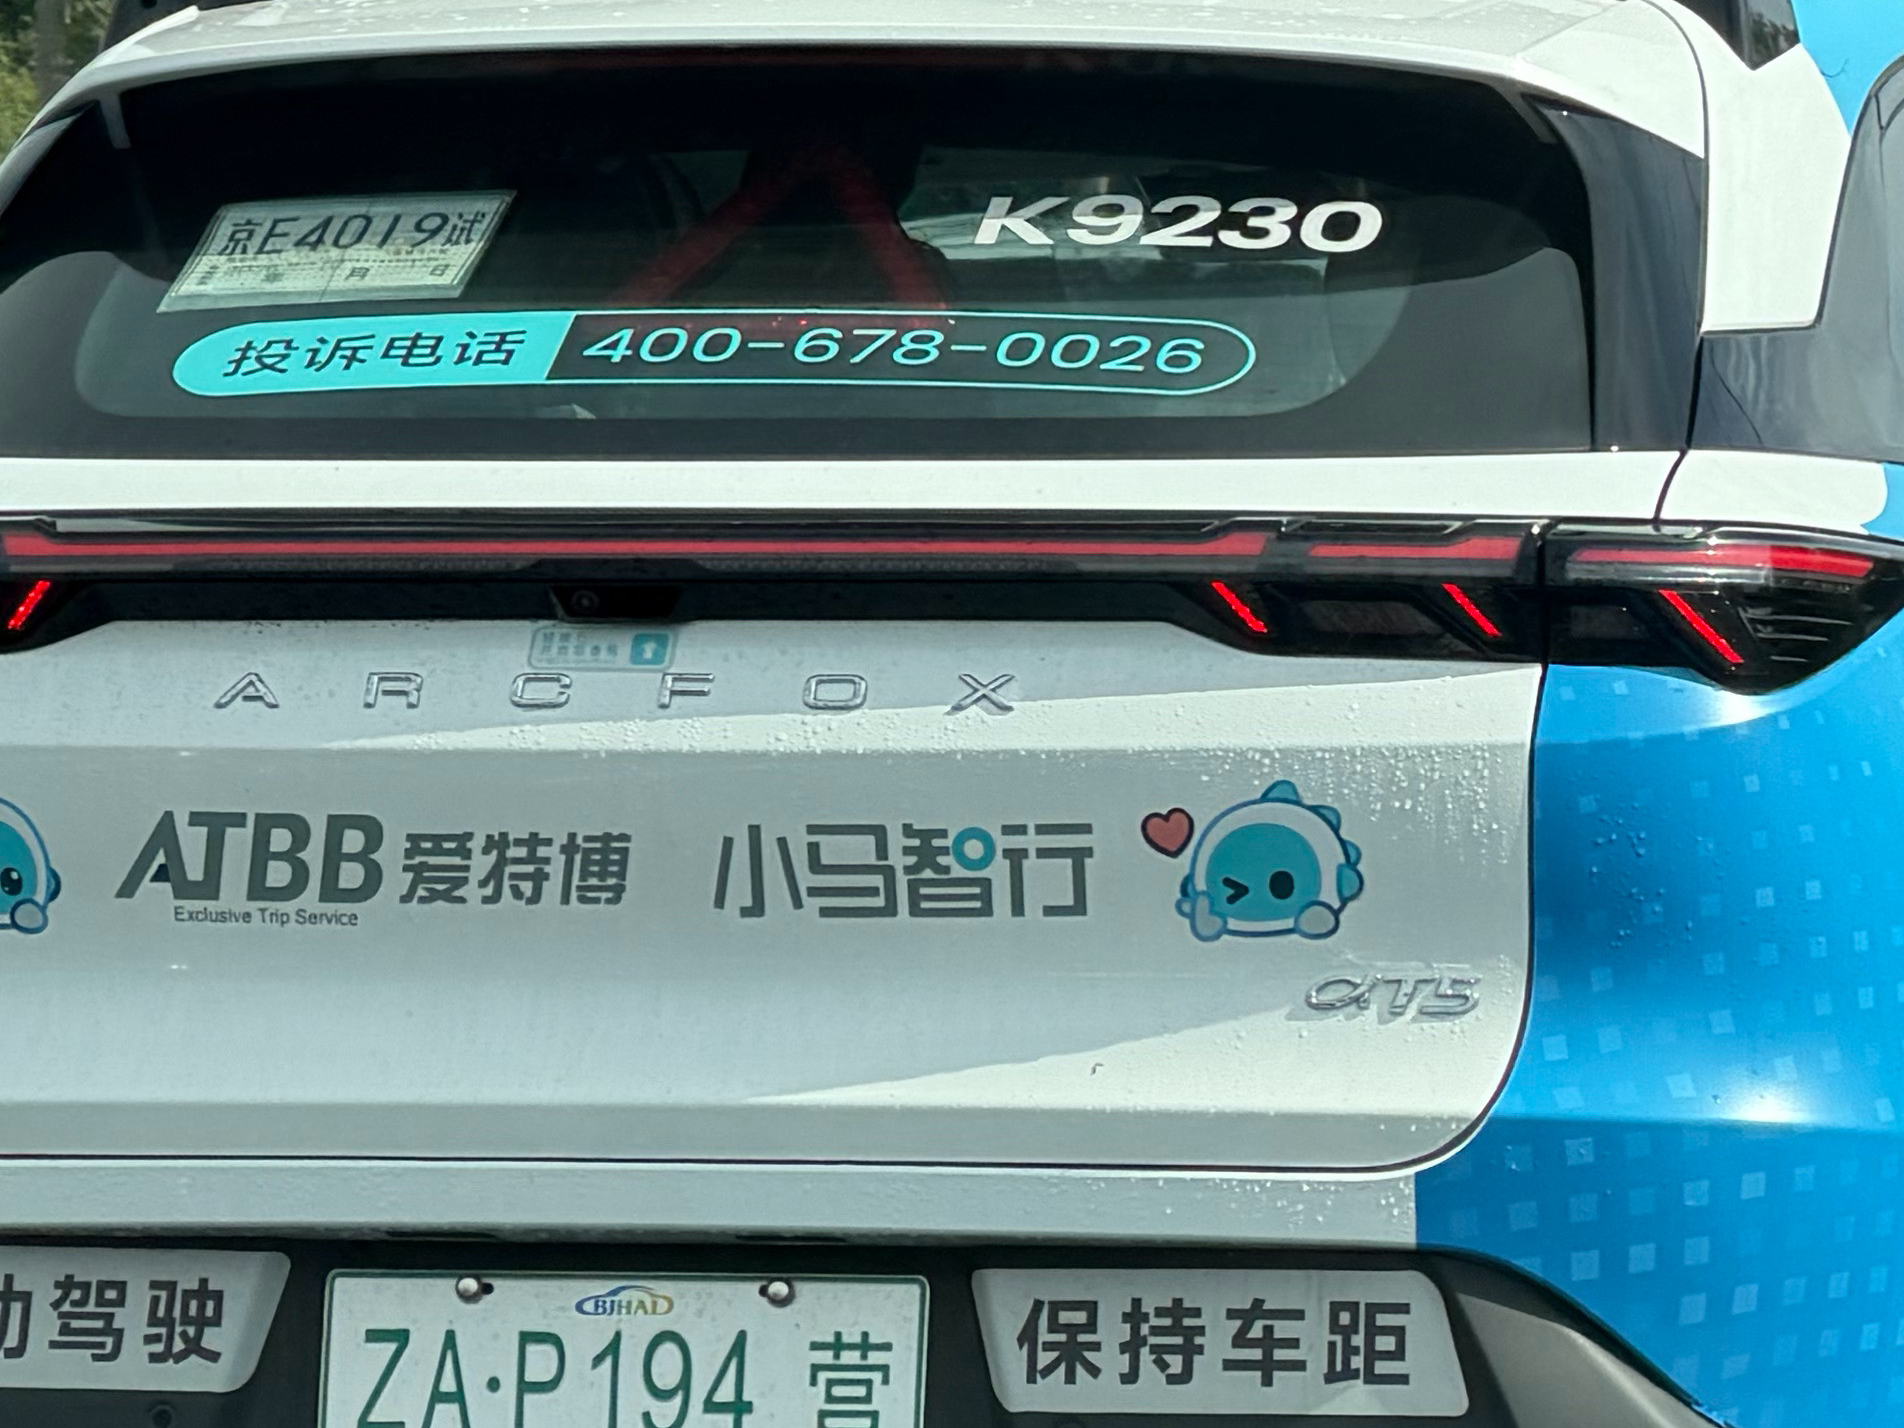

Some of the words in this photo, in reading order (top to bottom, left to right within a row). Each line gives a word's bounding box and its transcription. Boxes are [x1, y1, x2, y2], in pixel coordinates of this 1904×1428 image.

[217, 211, 487, 256] 京E4019试
[972, 194, 1383, 253] K9230
[222, 329, 528, 378] 投诉电话
[581, 325, 1205, 374] 400-678-0026
[215, 670, 1017, 715] ARCFOX
[115, 810, 384, 904] ATBB
[401, 830, 632, 907] 爱特博
[713, 822, 1094, 918] 小马智行
[174, 906, 252, 924] Exclusive
[257, 907, 290, 927] Trip
[295, 908, 359, 926] Service
[1016, 1298, 1412, 1387] 保持车距
